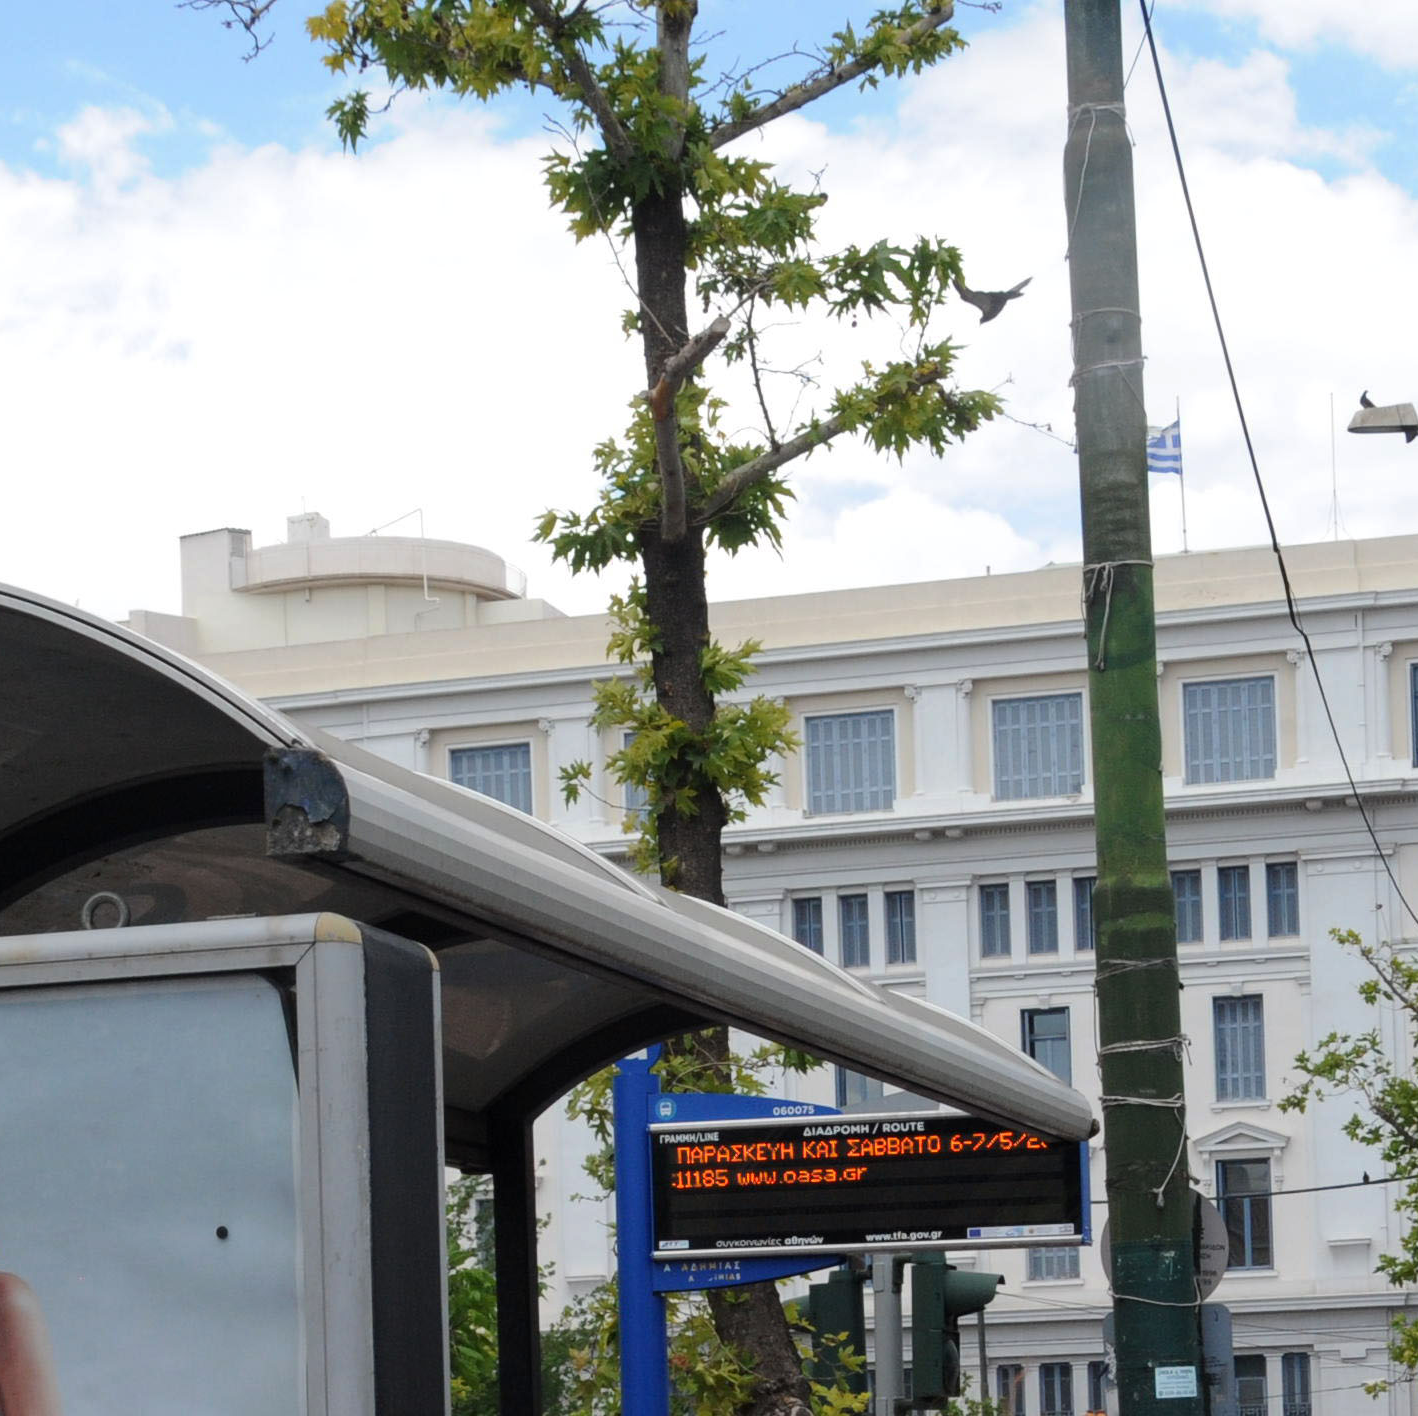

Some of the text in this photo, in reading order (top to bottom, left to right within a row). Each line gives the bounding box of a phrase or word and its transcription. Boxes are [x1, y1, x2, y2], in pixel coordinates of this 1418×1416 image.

[772, 1105, 815, 1116] 060075
[803, 1123, 870, 1137] ΔΙΑΔΡΟΜΗ
[882, 1121, 925, 1133] ROUTE
[659, 1131, 720, 1144] ΓΡΑΜΜΗ/LINE
[677, 1142, 794, 1164] ΠΑΡΑΣΚΕΥΗ
[802, 1138, 838, 1159] ΚΑΙ
[846, 1135, 941, 1157] ΣΑΒΒΑΤΟ
[716, 1230, 943, 1248] συγκοινωνίες αθηνών www.tfa.gov.gr
